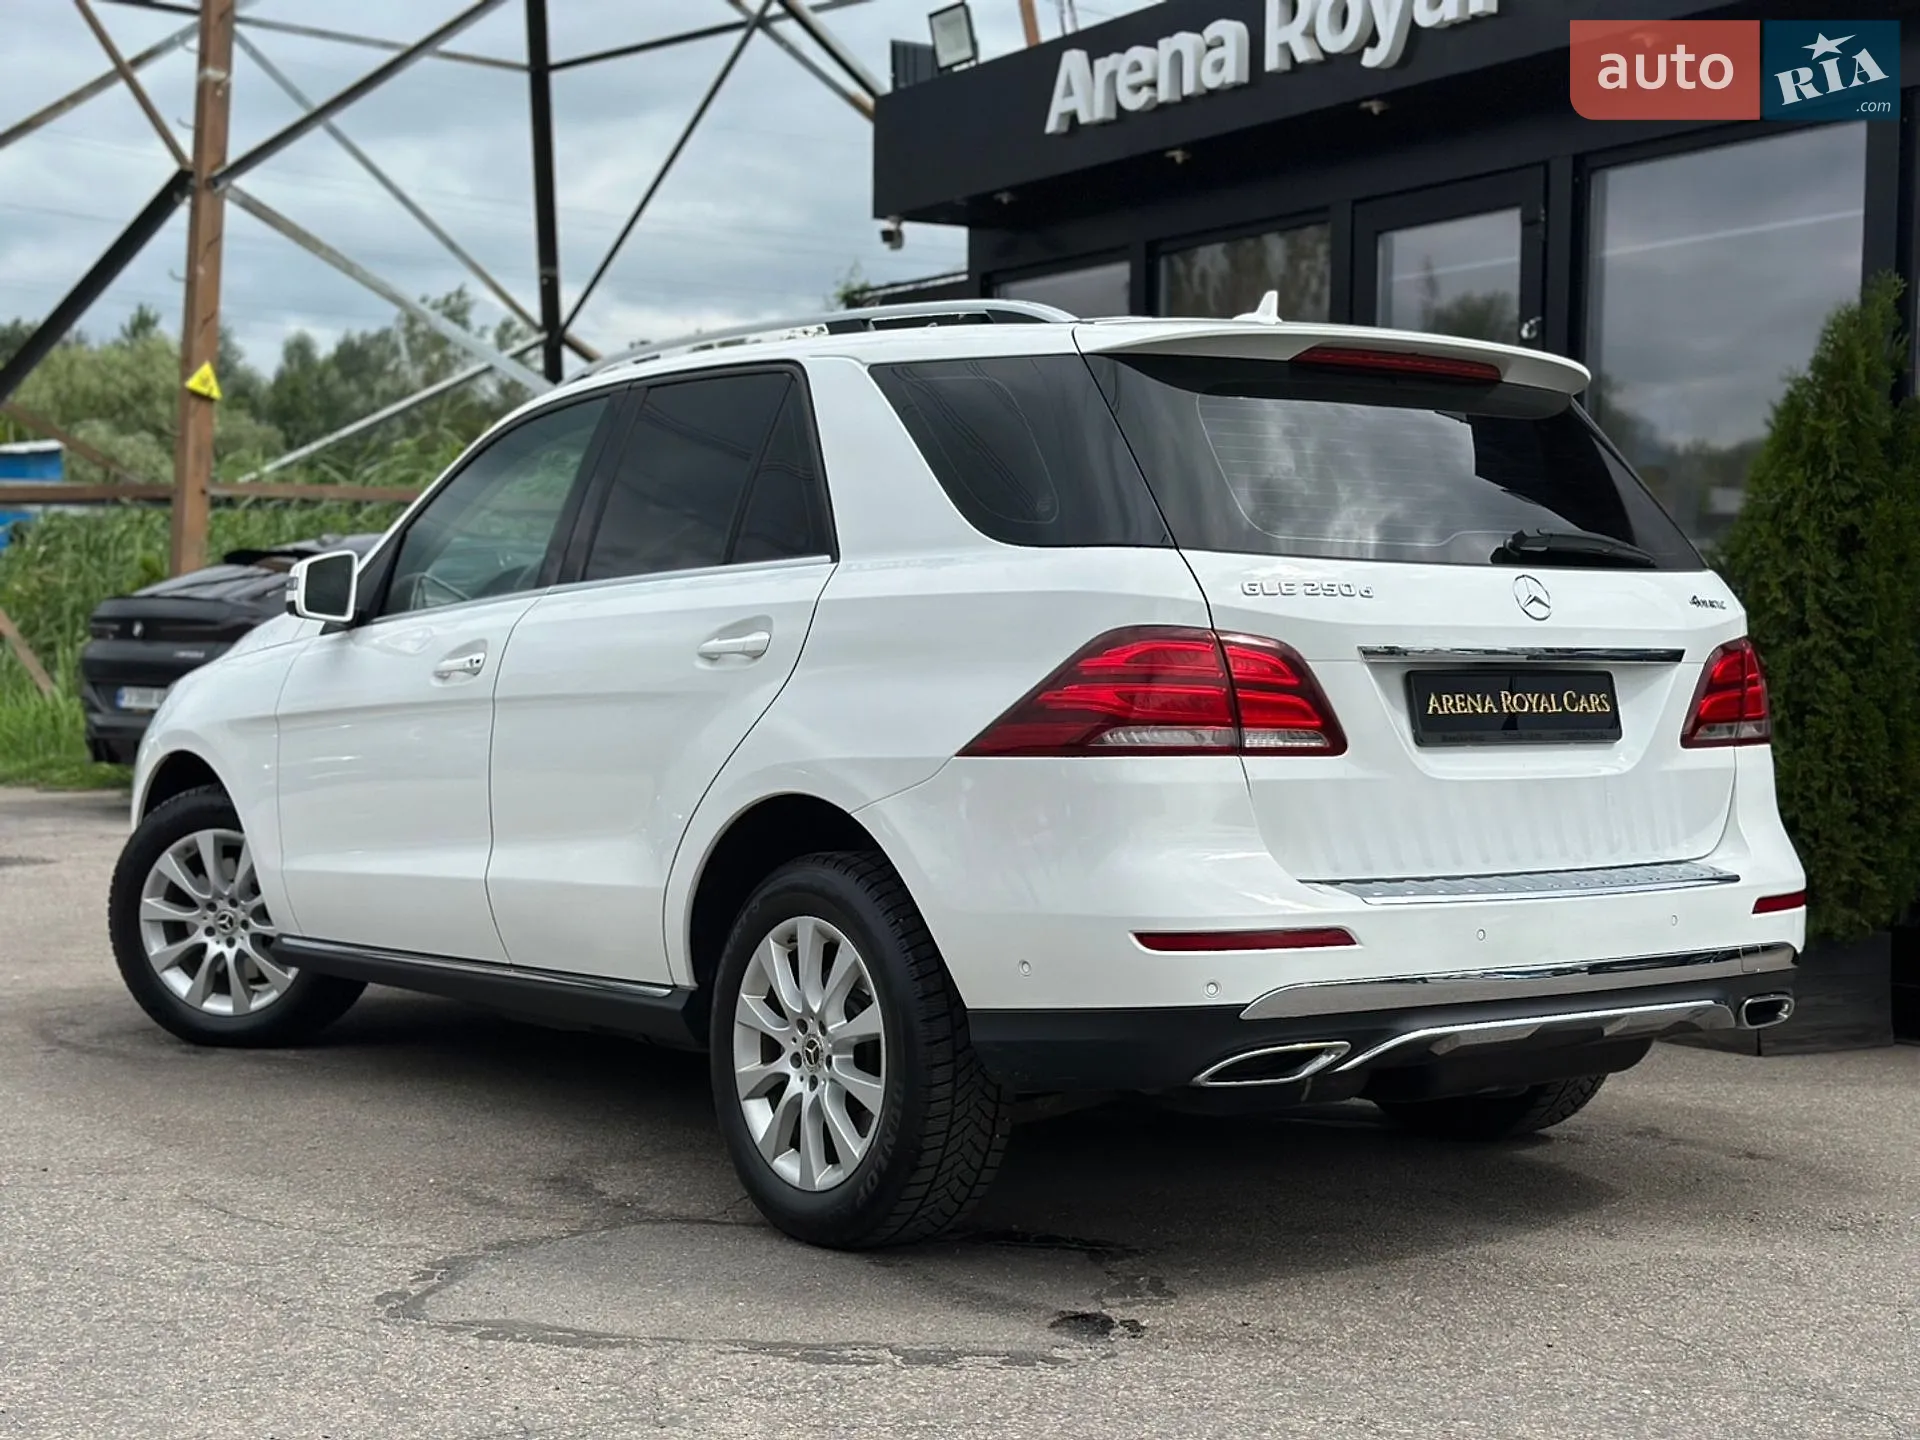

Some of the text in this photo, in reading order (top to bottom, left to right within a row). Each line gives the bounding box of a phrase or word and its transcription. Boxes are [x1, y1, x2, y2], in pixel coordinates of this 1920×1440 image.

[1045, 0, 1498, 134] Arena Roy
[1241, 580, 1297, 596] GLE
[1427, 690, 1611, 714] ARENA ROYAL CARS
